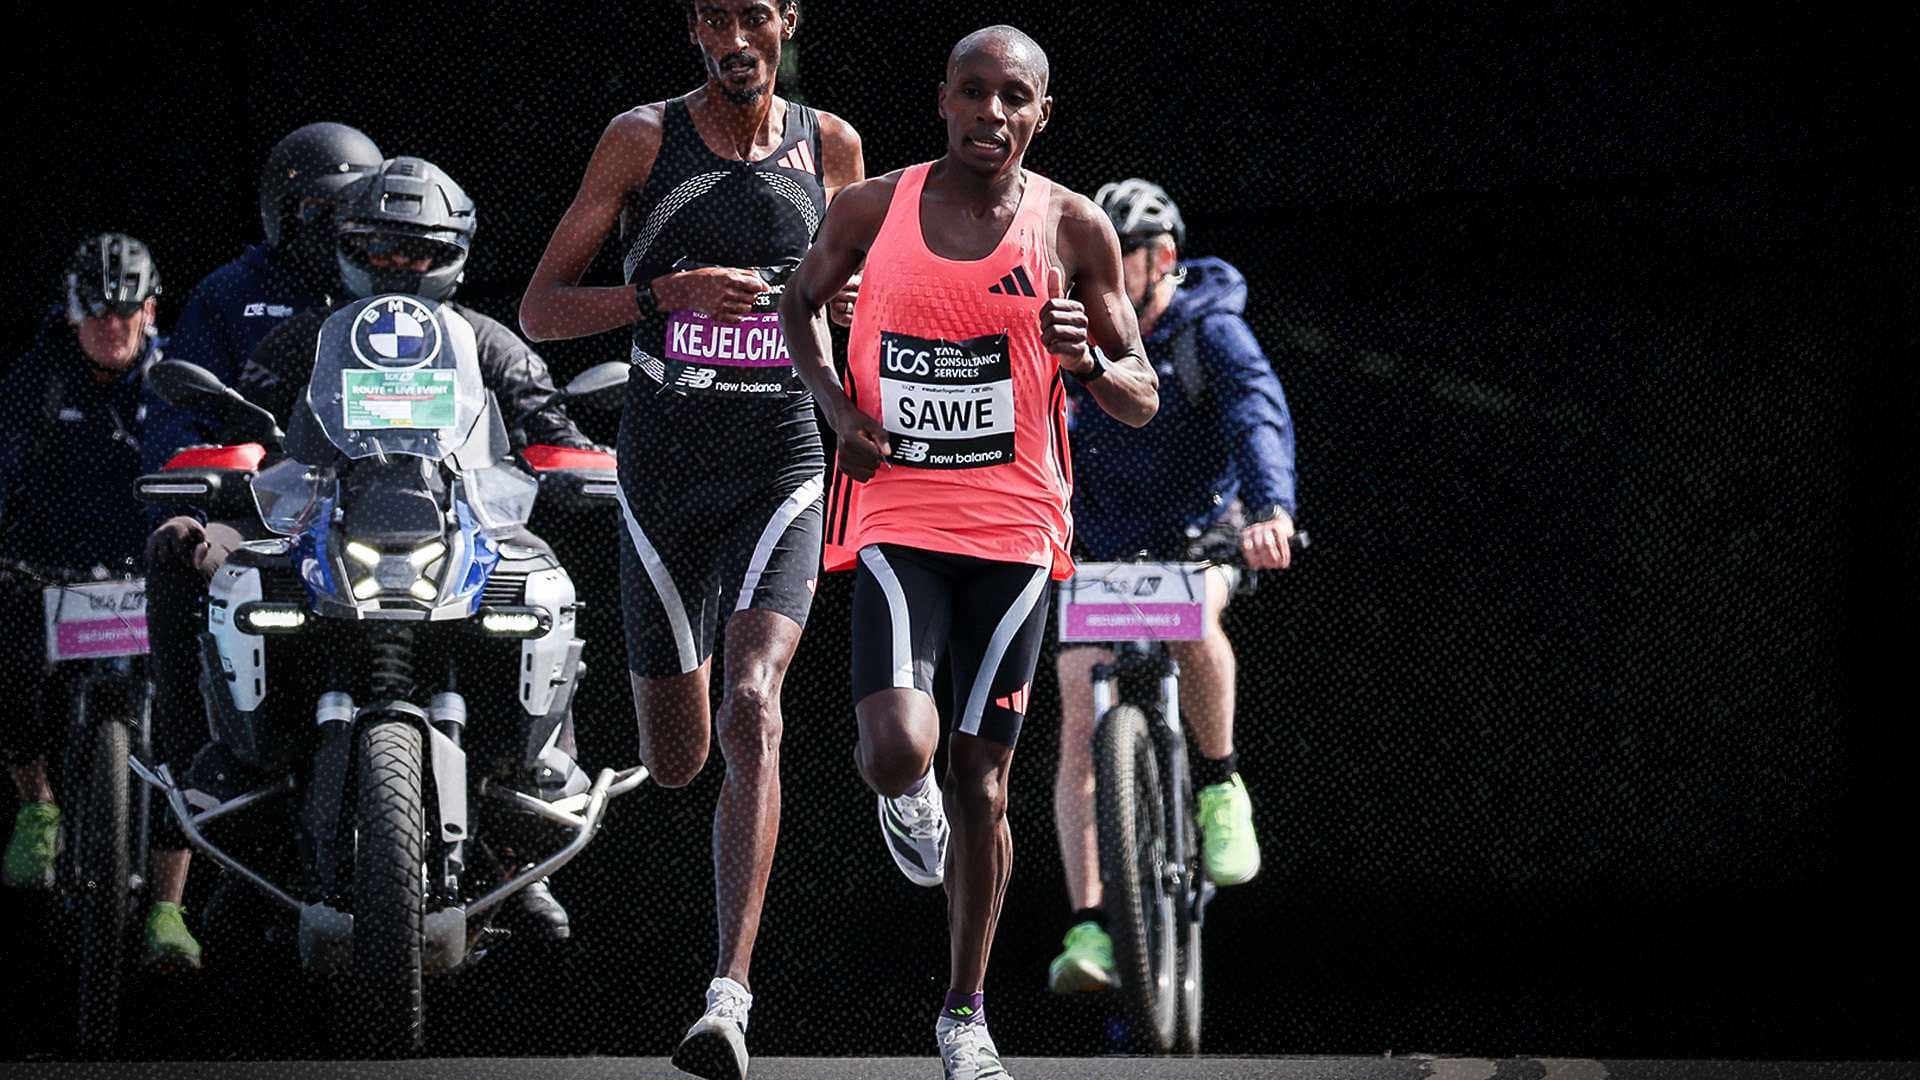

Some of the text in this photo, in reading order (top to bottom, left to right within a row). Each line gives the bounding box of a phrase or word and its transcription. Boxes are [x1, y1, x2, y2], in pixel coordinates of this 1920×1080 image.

[363, 300, 428, 324] BMW
[672, 321, 790, 361] KEJELCHA
[934, 347, 963, 357] TATA
[934, 353, 1001, 367] CONSULTANCY
[934, 368, 979, 378] SERVICES
[352, 385, 385, 394] ROUTE
[395, 385, 416, 395] LIVE
[416, 385, 449, 394] EVENT
[715, 382, 782, 393] new balance
[898, 396, 994, 432] SAWE
[930, 450, 1002, 464] new balance
